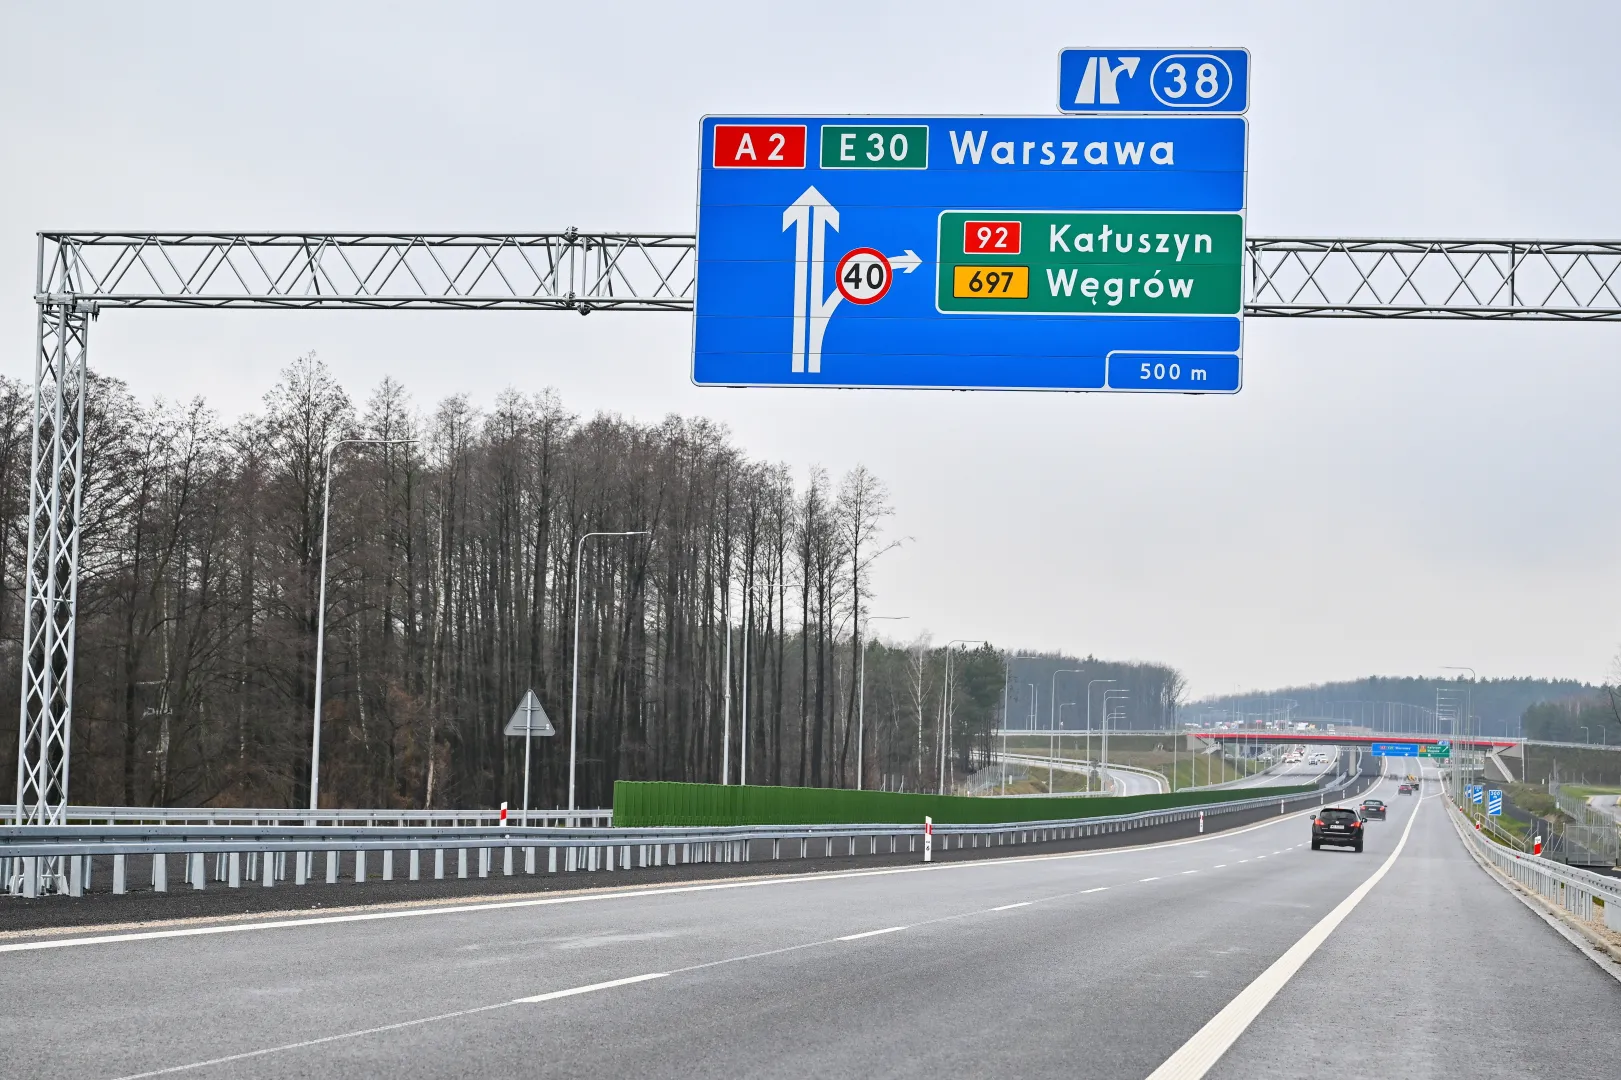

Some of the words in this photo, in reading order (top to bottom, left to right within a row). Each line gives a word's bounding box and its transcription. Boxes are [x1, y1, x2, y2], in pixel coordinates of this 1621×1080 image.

[1163, 63, 1219, 99] 38
[949, 130, 1174, 166] Warszawa
[977, 226, 1008, 249] 92
[1049, 224, 1212, 262] Kałuszyn
[843, 263, 884, 290] 40
[968, 270, 1014, 294] 697
[1046, 268, 1194, 307] Węgrów
[1140, 363, 1181, 380] 500
[1191, 368, 1207, 381] m
